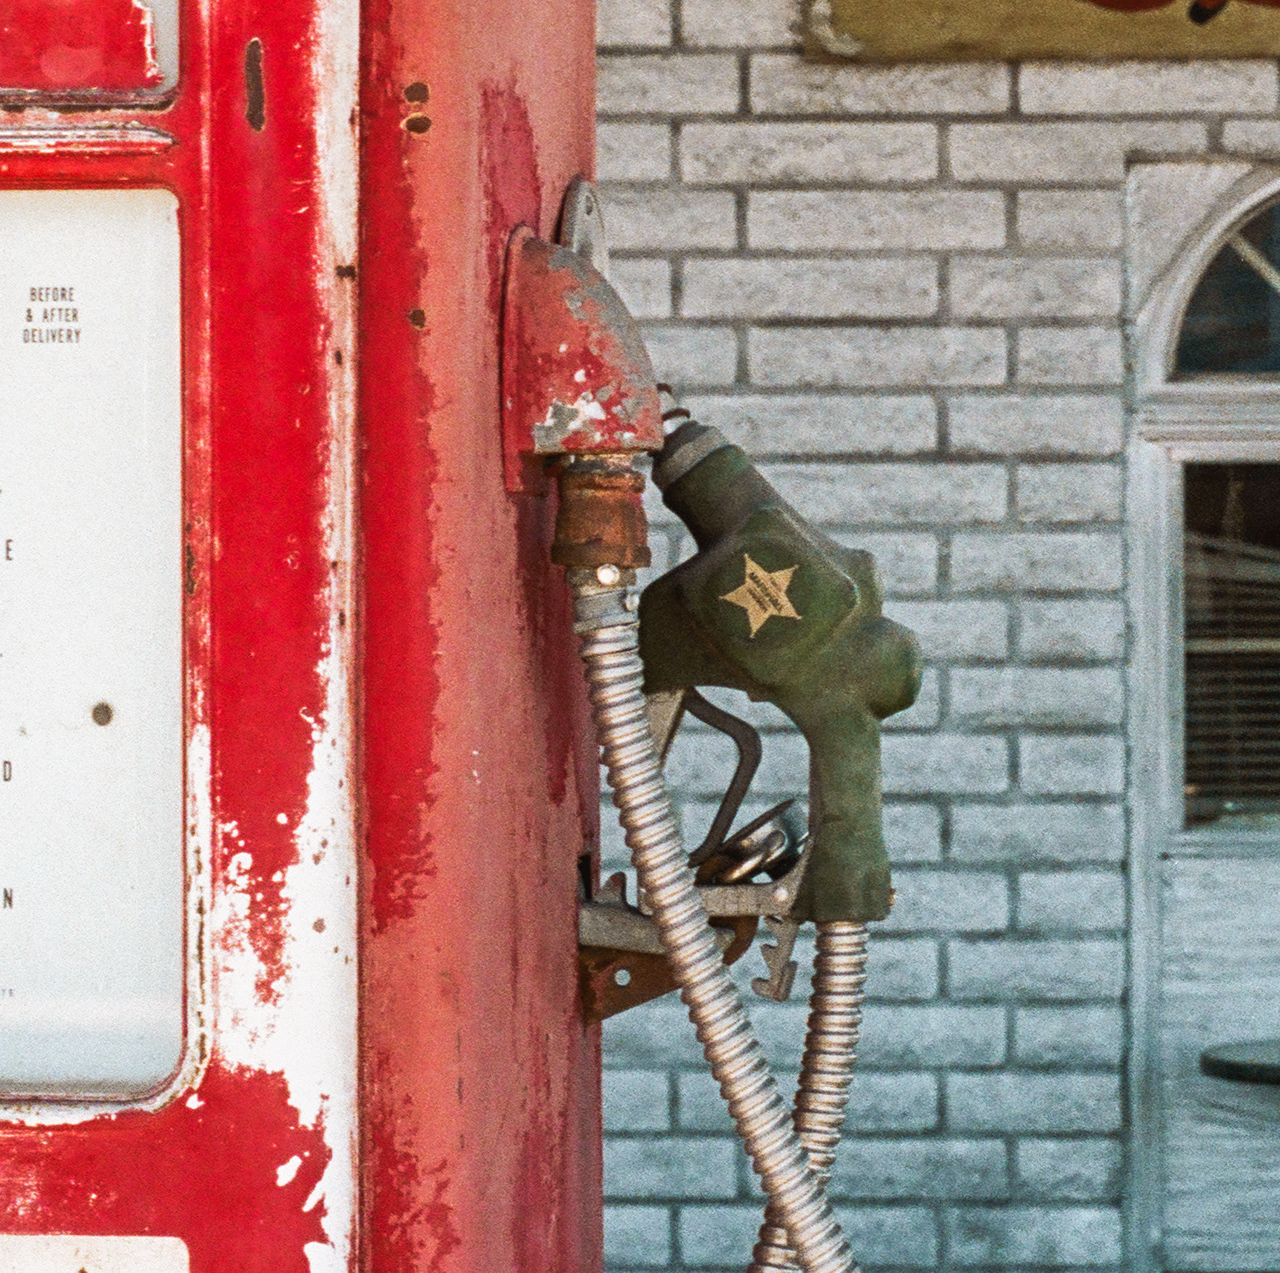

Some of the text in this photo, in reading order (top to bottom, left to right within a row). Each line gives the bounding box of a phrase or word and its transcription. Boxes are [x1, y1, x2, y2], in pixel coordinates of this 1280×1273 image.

[30, 286, 75, 302] BEFORE
[25, 307, 79, 323] & AFTER
[23, 328, 81, 344] DELIVERY
